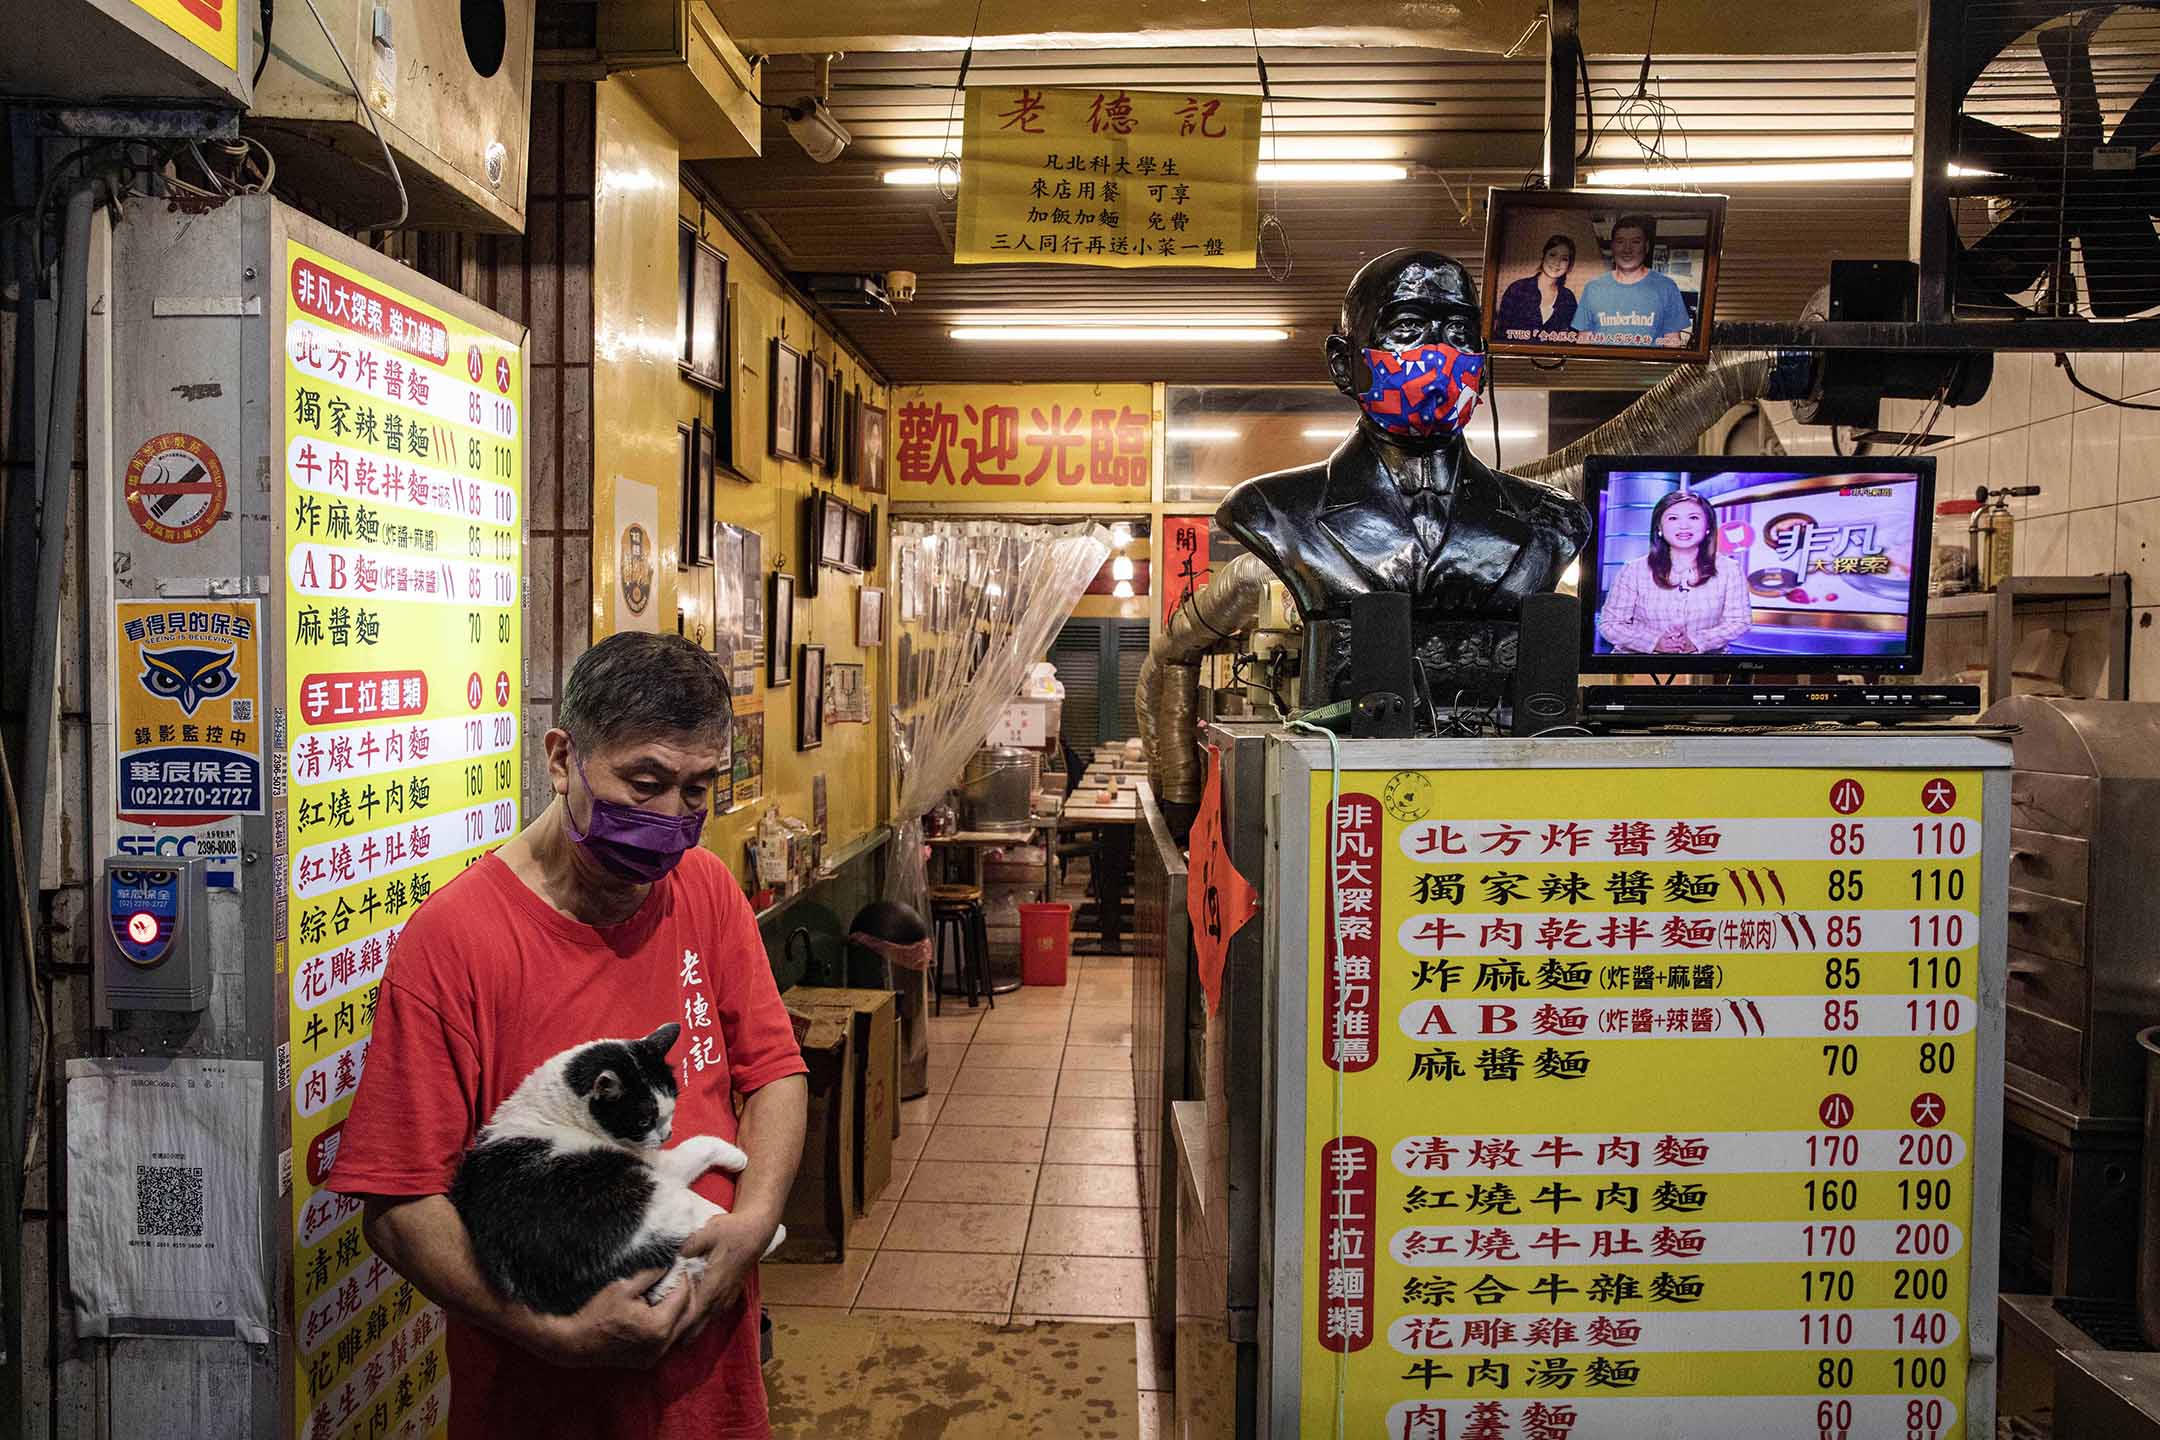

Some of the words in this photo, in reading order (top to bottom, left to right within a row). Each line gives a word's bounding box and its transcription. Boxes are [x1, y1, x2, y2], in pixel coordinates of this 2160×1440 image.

[998, 88, 1227, 138] 老德記
[1044, 155, 1180, 177] 凡北科大學生
[1030, 178, 1120, 203] 來店用餐
[1147, 183, 1190, 205] 可享
[1027, 206, 1119, 228] 加飯加麵
[1147, 211, 1190, 232] 免費
[990, 233, 1225, 257] 三人同行再送小菜一盤
[298, 269, 383, 333] 非凡大探索
[1598, 311, 1655, 326] Timberland
[296, 331, 429, 405] 北方炸醬麵
[469, 392, 481, 425] 85
[494, 400, 512, 435] 110
[294, 386, 429, 458] 獨家辣醬麵
[469, 437, 481, 471] 85
[494, 446, 512, 479] 110
[896, 400, 1150, 487] 歡迎光臨
[469, 484, 481, 516] 85
[494, 489, 512, 521] 110
[469, 526, 481, 557] 85
[494, 530, 512, 561] 110
[1776, 523, 1883, 583] 非凡
[1812, 556, 1890, 575] 大探索
[469, 569, 481, 599] 85
[494, 569, 512, 601] 110
[124, 612, 252, 641] 看得見的保全
[295, 604, 380, 646] 麻醬麵
[469, 613, 481, 644] 70
[498, 613, 511, 643] 80
[307, 678, 421, 717] 手工拉麵類
[135, 725, 246, 747] 錄影監控中
[297, 725, 430, 778] 清燉牛肉麵
[465, 721, 483, 753] 170
[494, 716, 511, 748] 200
[130, 761, 253, 783] 華辰保全
[272, 753, 282, 796] 2396-5073
[131, 787, 252, 806] (02)2270-2727
[297, 775, 430, 833] 紅燒牛肉麵
[465, 765, 483, 797] 160
[494, 759, 511, 791] 190
[1836, 783, 1859, 811] 小
[1926, 782, 1950, 810] 大
[298, 825, 431, 891] 紅燒牛肚麵
[465, 809, 484, 842] 170
[494, 802, 512, 834] 200
[1415, 821, 1722, 857] 北方炸醬麵
[1829, 823, 1865, 855] 85
[1912, 822, 1966, 854] 110
[1334, 804, 1373, 941] 非凡大探索
[1411, 870, 1720, 905] 獨家辣醬麵
[1828, 869, 1863, 901] 85
[1911, 869, 1964, 901] 110
[300, 872, 431, 945] 綜合牛雜麵
[1827, 916, 1862, 947] 85
[1909, 914, 1962, 947] 110
[1825, 957, 1860, 989] 85
[1908, 956, 1961, 988] 110
[680, 949, 721, 1071] 老德記
[1332, 955, 1371, 1062] 強力推薦
[1824, 1000, 1859, 1032] 85
[1906, 999, 1960, 1031] 110
[304, 1042, 369, 1110] 肉羹
[1407, 1047, 1591, 1082] 麻醬麵
[1823, 1044, 1858, 1076] 70
[1919, 1042, 1955, 1074] 80
[1826, 1097, 1849, 1125] 小
[1916, 1096, 1940, 1123] 大
[1404, 1135, 1710, 1170] 清燉牛肉麵
[1805, 1135, 1859, 1167] 170
[1898, 1134, 1953, 1166] 200
[1402, 1181, 1708, 1215] 紅燒牛肉麵
[1804, 1179, 1857, 1211] 160
[1898, 1179, 1950, 1210] 190
[1327, 1148, 1368, 1339] 手工拉麵類
[1401, 1226, 1706, 1260] 紅燒牛肚麵
[1803, 1225, 1856, 1257] 170
[1895, 1223, 1949, 1255] 200
[306, 1227, 360, 1296] 清燉
[306, 1257, 394, 1348] 紅燒牛
[1402, 1272, 1705, 1307] 綜合牛雜麵
[1801, 1270, 1854, 1302] 170
[1894, 1268, 1948, 1300] 200
[1401, 1316, 1643, 1350] 花雕雞麵
[1799, 1313, 1853, 1345] 110
[1893, 1313, 1946, 1344] 140
[1401, 1356, 1642, 1390] 牛肉湯麵
[1818, 1358, 1853, 1388] 80
[1893, 1357, 1946, 1388] 100
[1403, 1401, 1578, 1440] 肉羹麵
[1816, 1400, 1852, 1430] 60
[1906, 1399, 1942, 1430] 80
